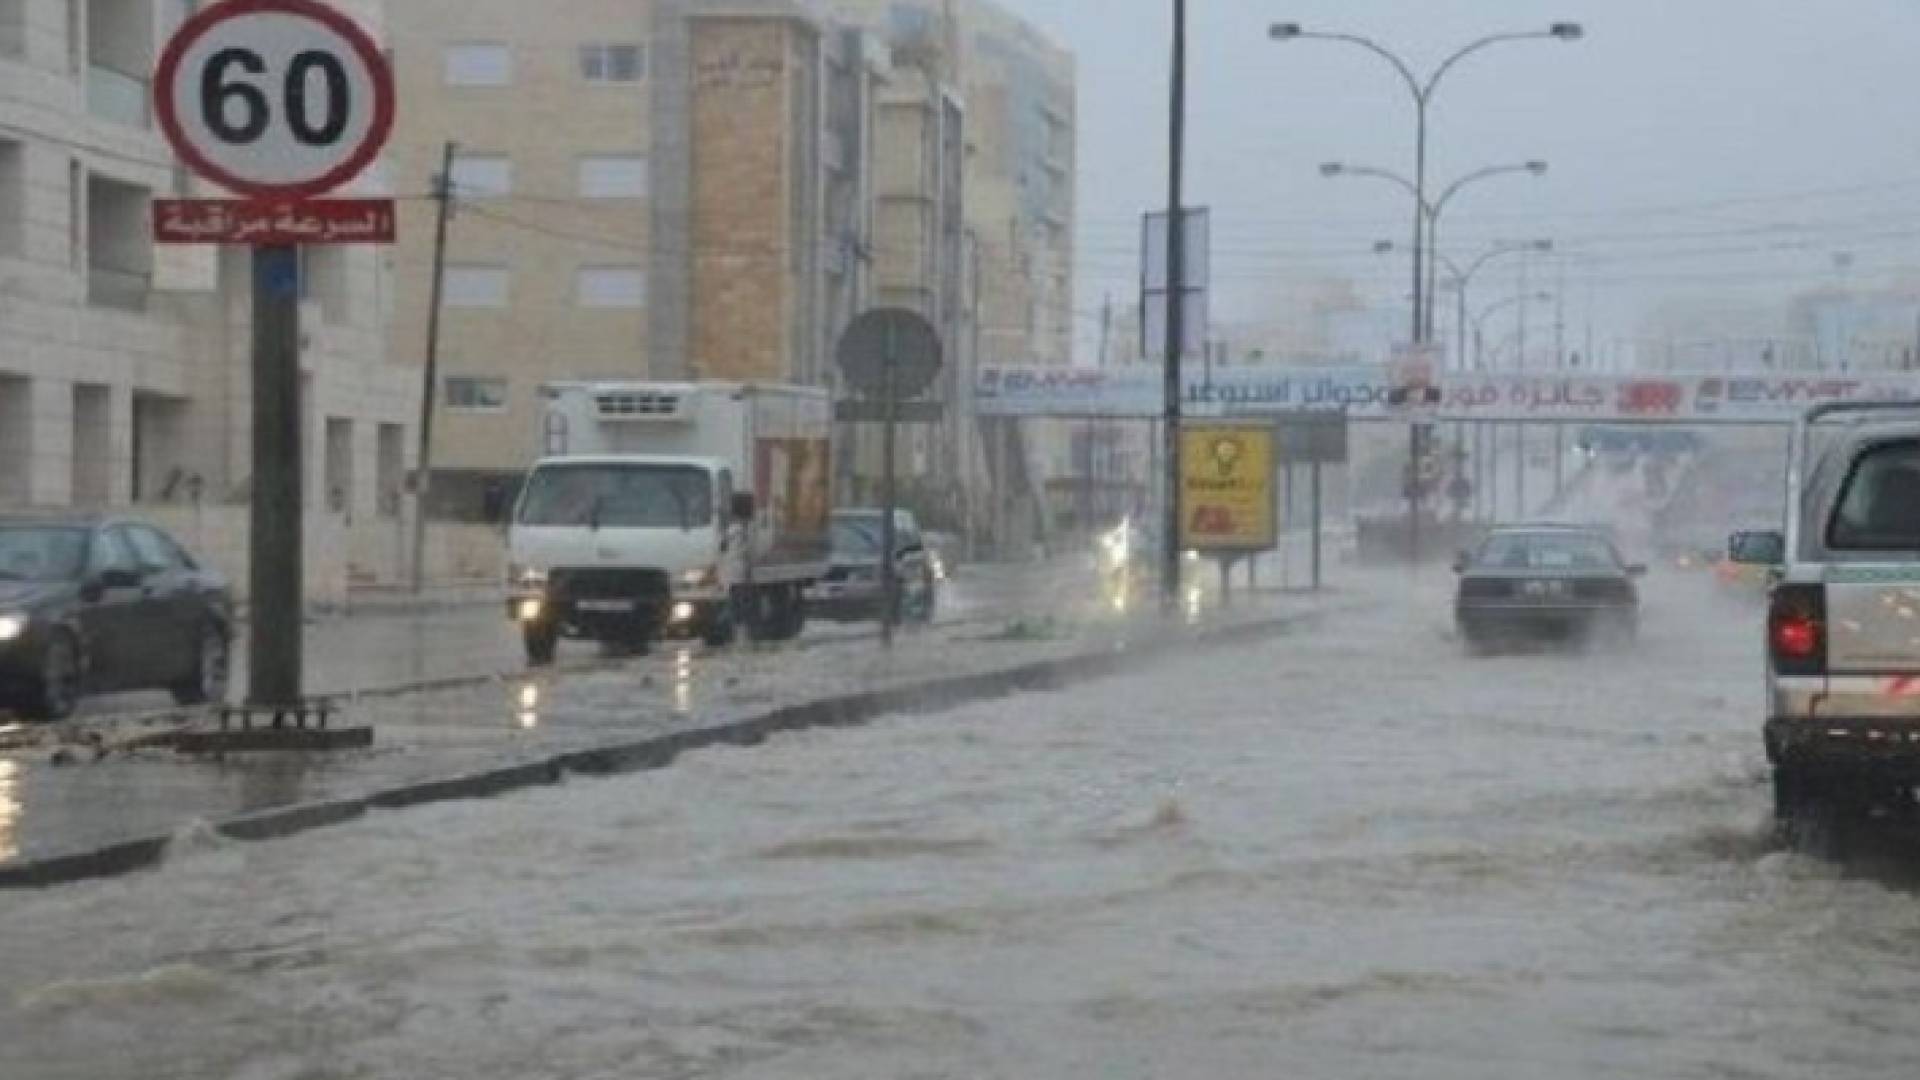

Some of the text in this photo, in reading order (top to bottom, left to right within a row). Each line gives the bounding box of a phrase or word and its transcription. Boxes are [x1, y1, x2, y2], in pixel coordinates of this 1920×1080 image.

[201, 47, 350, 147] 60
[161, 204, 390, 241] السرعة مراقبة
